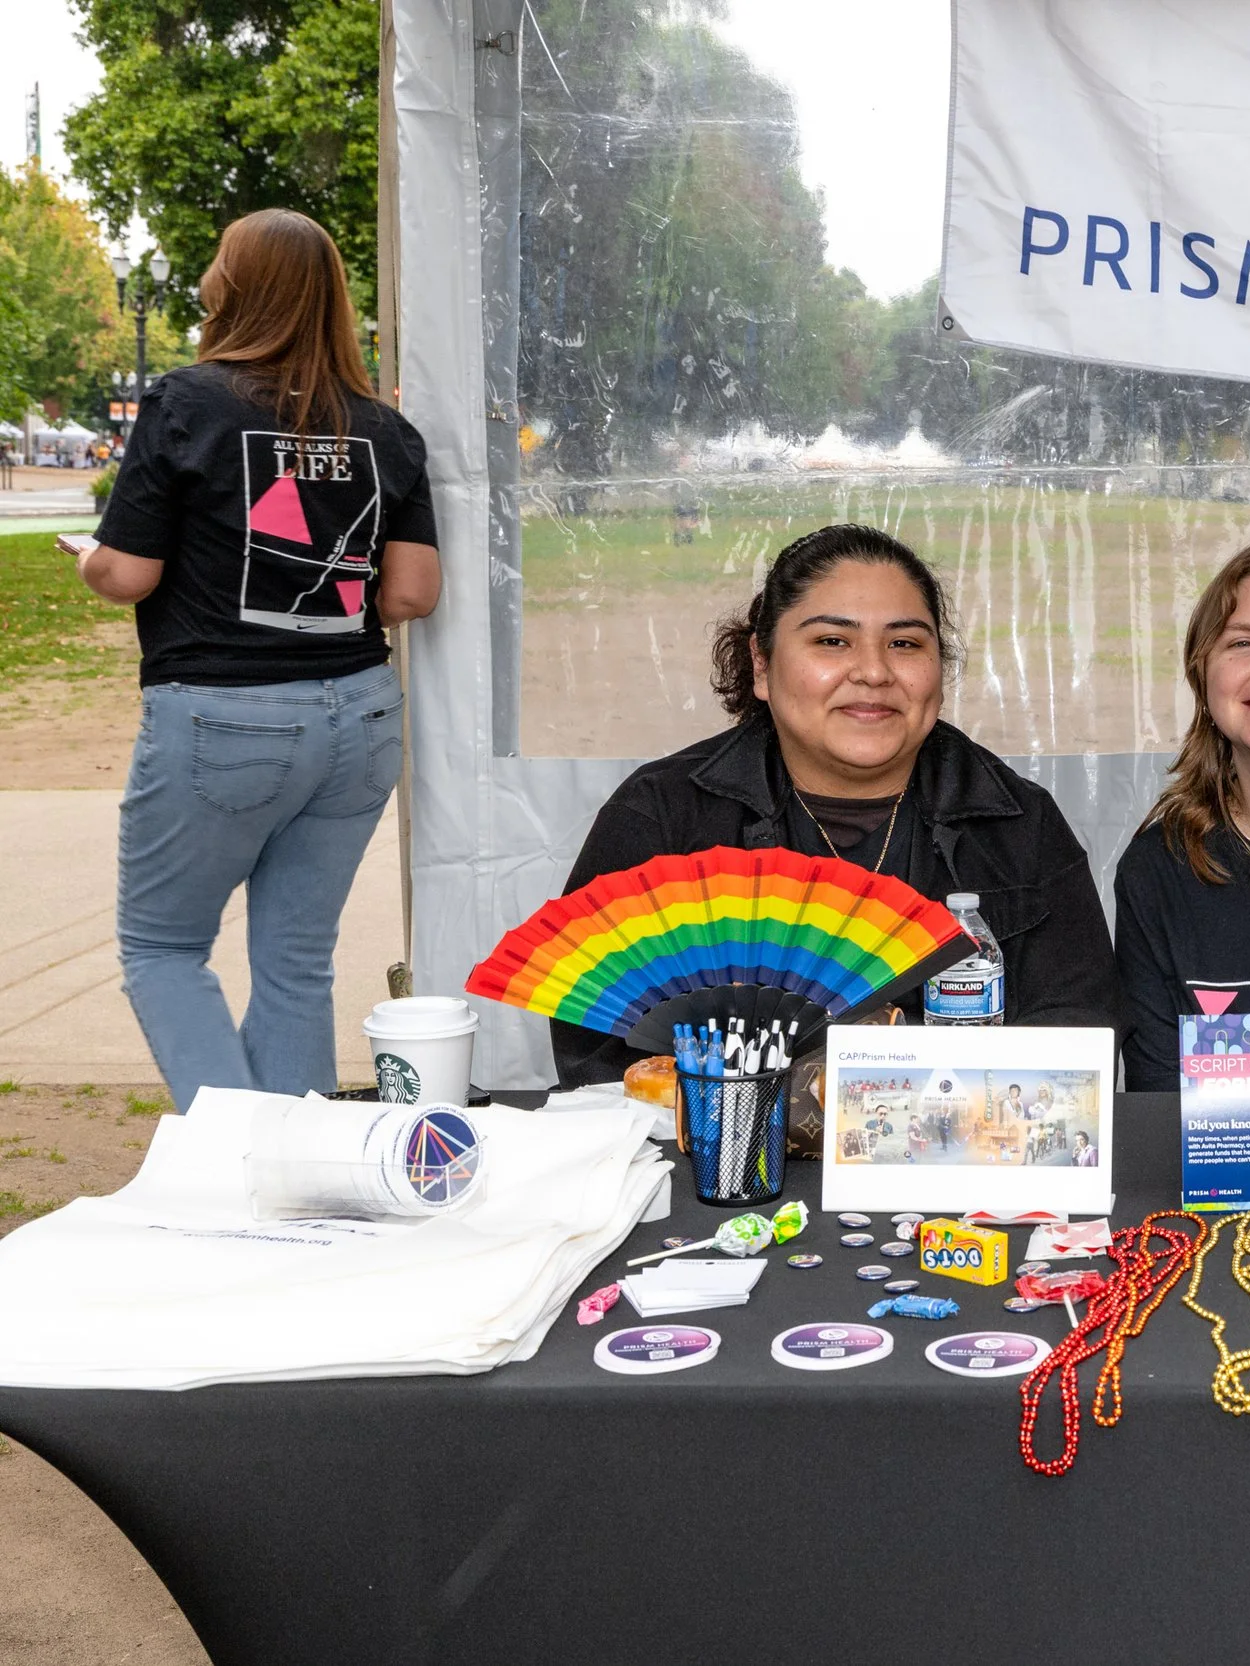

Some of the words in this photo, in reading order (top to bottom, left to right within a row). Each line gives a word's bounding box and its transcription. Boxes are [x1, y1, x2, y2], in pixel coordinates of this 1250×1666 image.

[273, 440, 295, 451] ALL
[295, 441, 333, 453] WALKS
[273, 451, 353, 481] LIFE
[941, 982, 983, 991] KIRKLAND
[838, 1052, 886, 1062] CAP/Prism
[889, 1052, 917, 1062] Health
[1190, 1057, 1247, 1073] SCRIPT
[1188, 1119, 1208, 1131] Did
[1208, 1121, 1230, 1132] you
[1188, 1150, 1214, 1158] generate
[924, 1248, 981, 1269] DOTS
[658, 1340, 697, 1348] HEALTH
